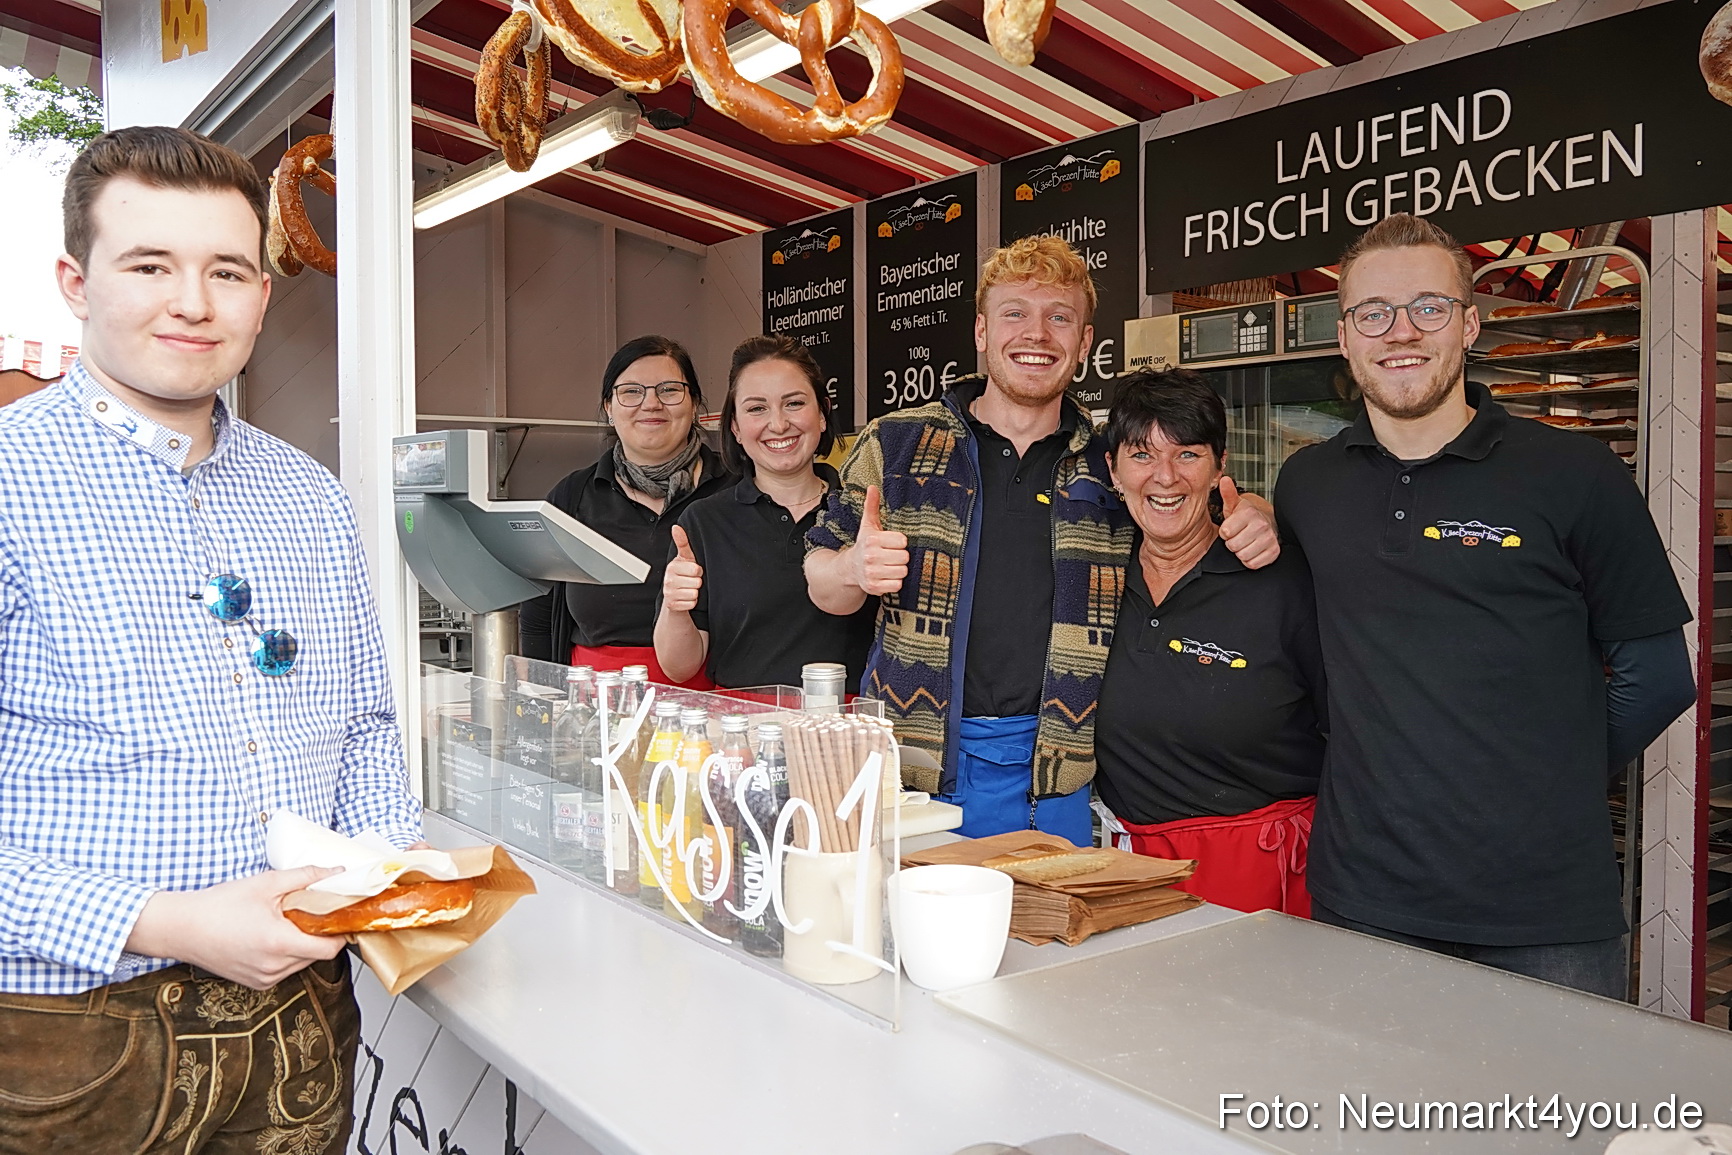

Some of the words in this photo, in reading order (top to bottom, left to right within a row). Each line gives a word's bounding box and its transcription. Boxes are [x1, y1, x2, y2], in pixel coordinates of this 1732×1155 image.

[1276, 88, 1512, 184] LAUFEND
[1184, 187, 1330, 258] FRISCH
[1345, 123, 1645, 226] GEBACKEN
[1031, 215, 1106, 243] kühlte
[880, 251, 960, 287] Bayerischer
[767, 277, 846, 309] Holländischer
[877, 277, 964, 312] Emmentaler
[770, 303, 844, 333] Leerdammer
[890, 318, 902, 332] 45
[902, 316, 912, 330] %
[913, 314, 930, 329] Fett
[937, 309, 948, 324] Tr.
[801, 333, 816, 347] Fett
[822, 330, 831, 344] Tr.
[908, 346, 930, 361] 100g
[1092, 338, 1115, 380] €
[1130, 355, 1153, 367] MIWE
[883, 364, 935, 408] 3,80
